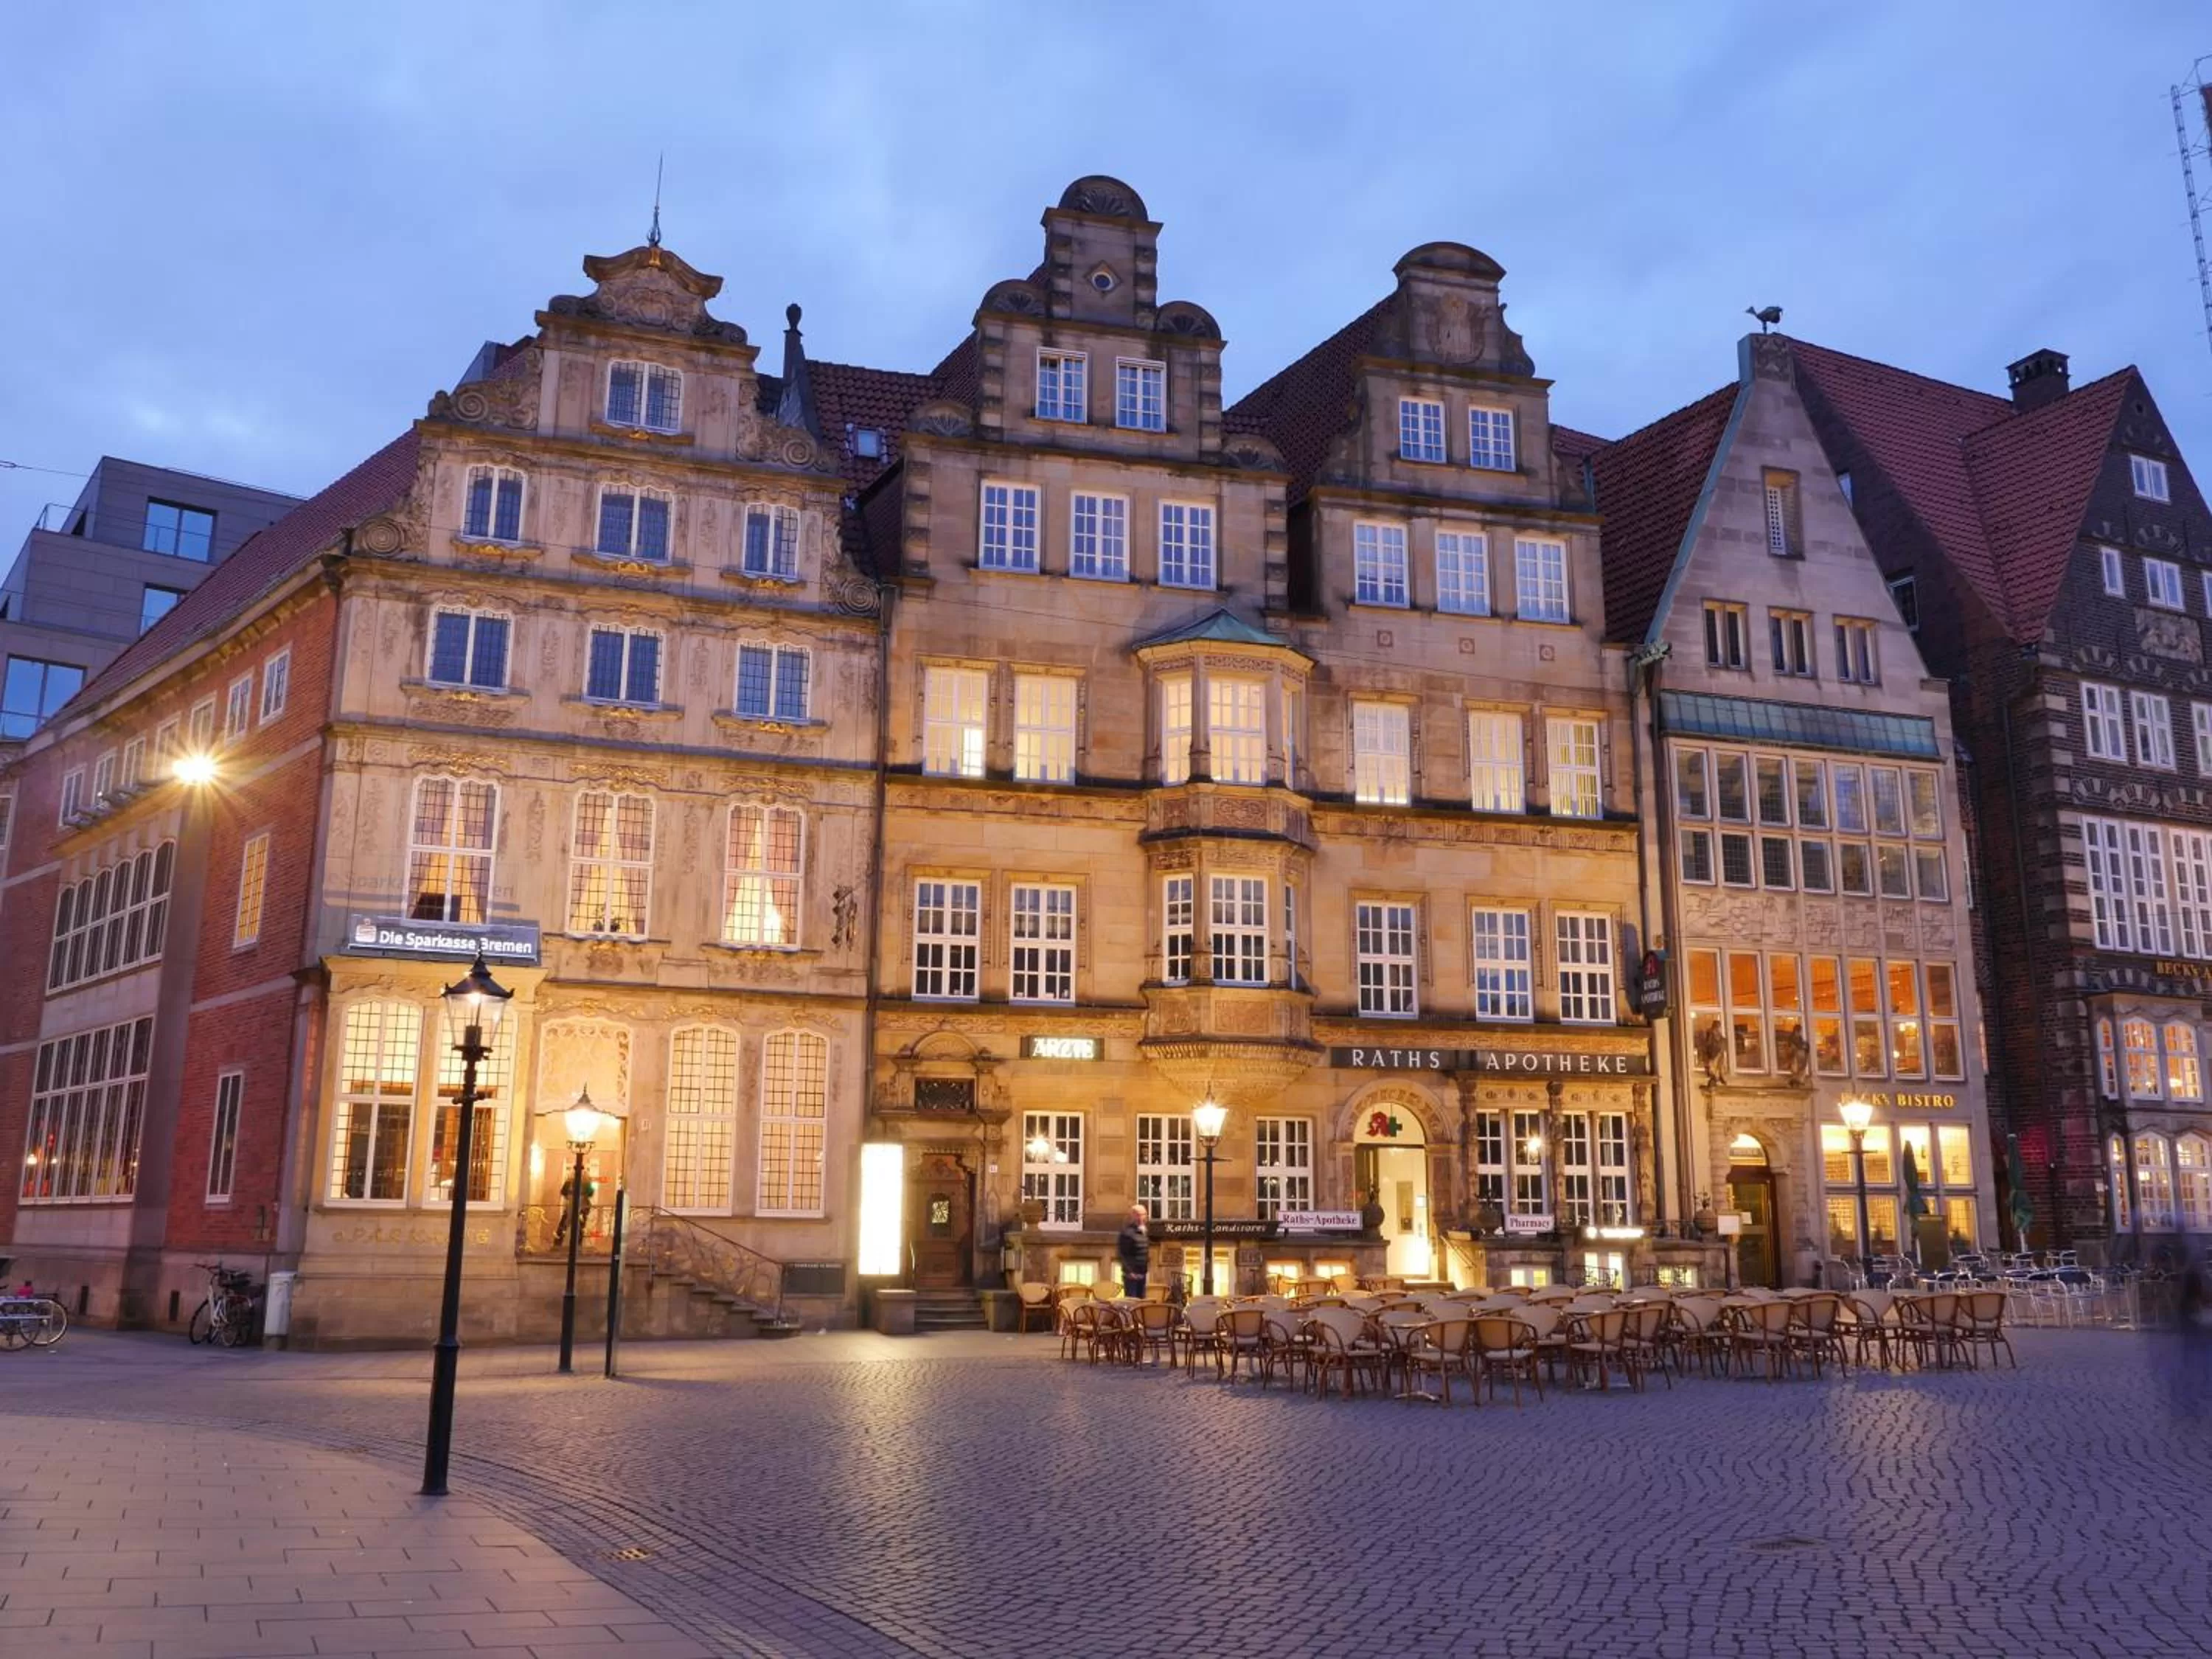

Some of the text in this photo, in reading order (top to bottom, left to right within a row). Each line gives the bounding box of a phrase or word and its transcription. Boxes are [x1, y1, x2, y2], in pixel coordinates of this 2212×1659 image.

[380, 931, 402, 945] Die
[406, 932, 476, 950] Sparkasse
[1352, 1048, 1627, 1074] RATHS APOTHEKE
[1896, 1093, 1955, 1108] BISTRO
[1164, 1222, 1267, 1234] Raths-onditorei
[1509, 1217, 1550, 1229] Pharmacy
